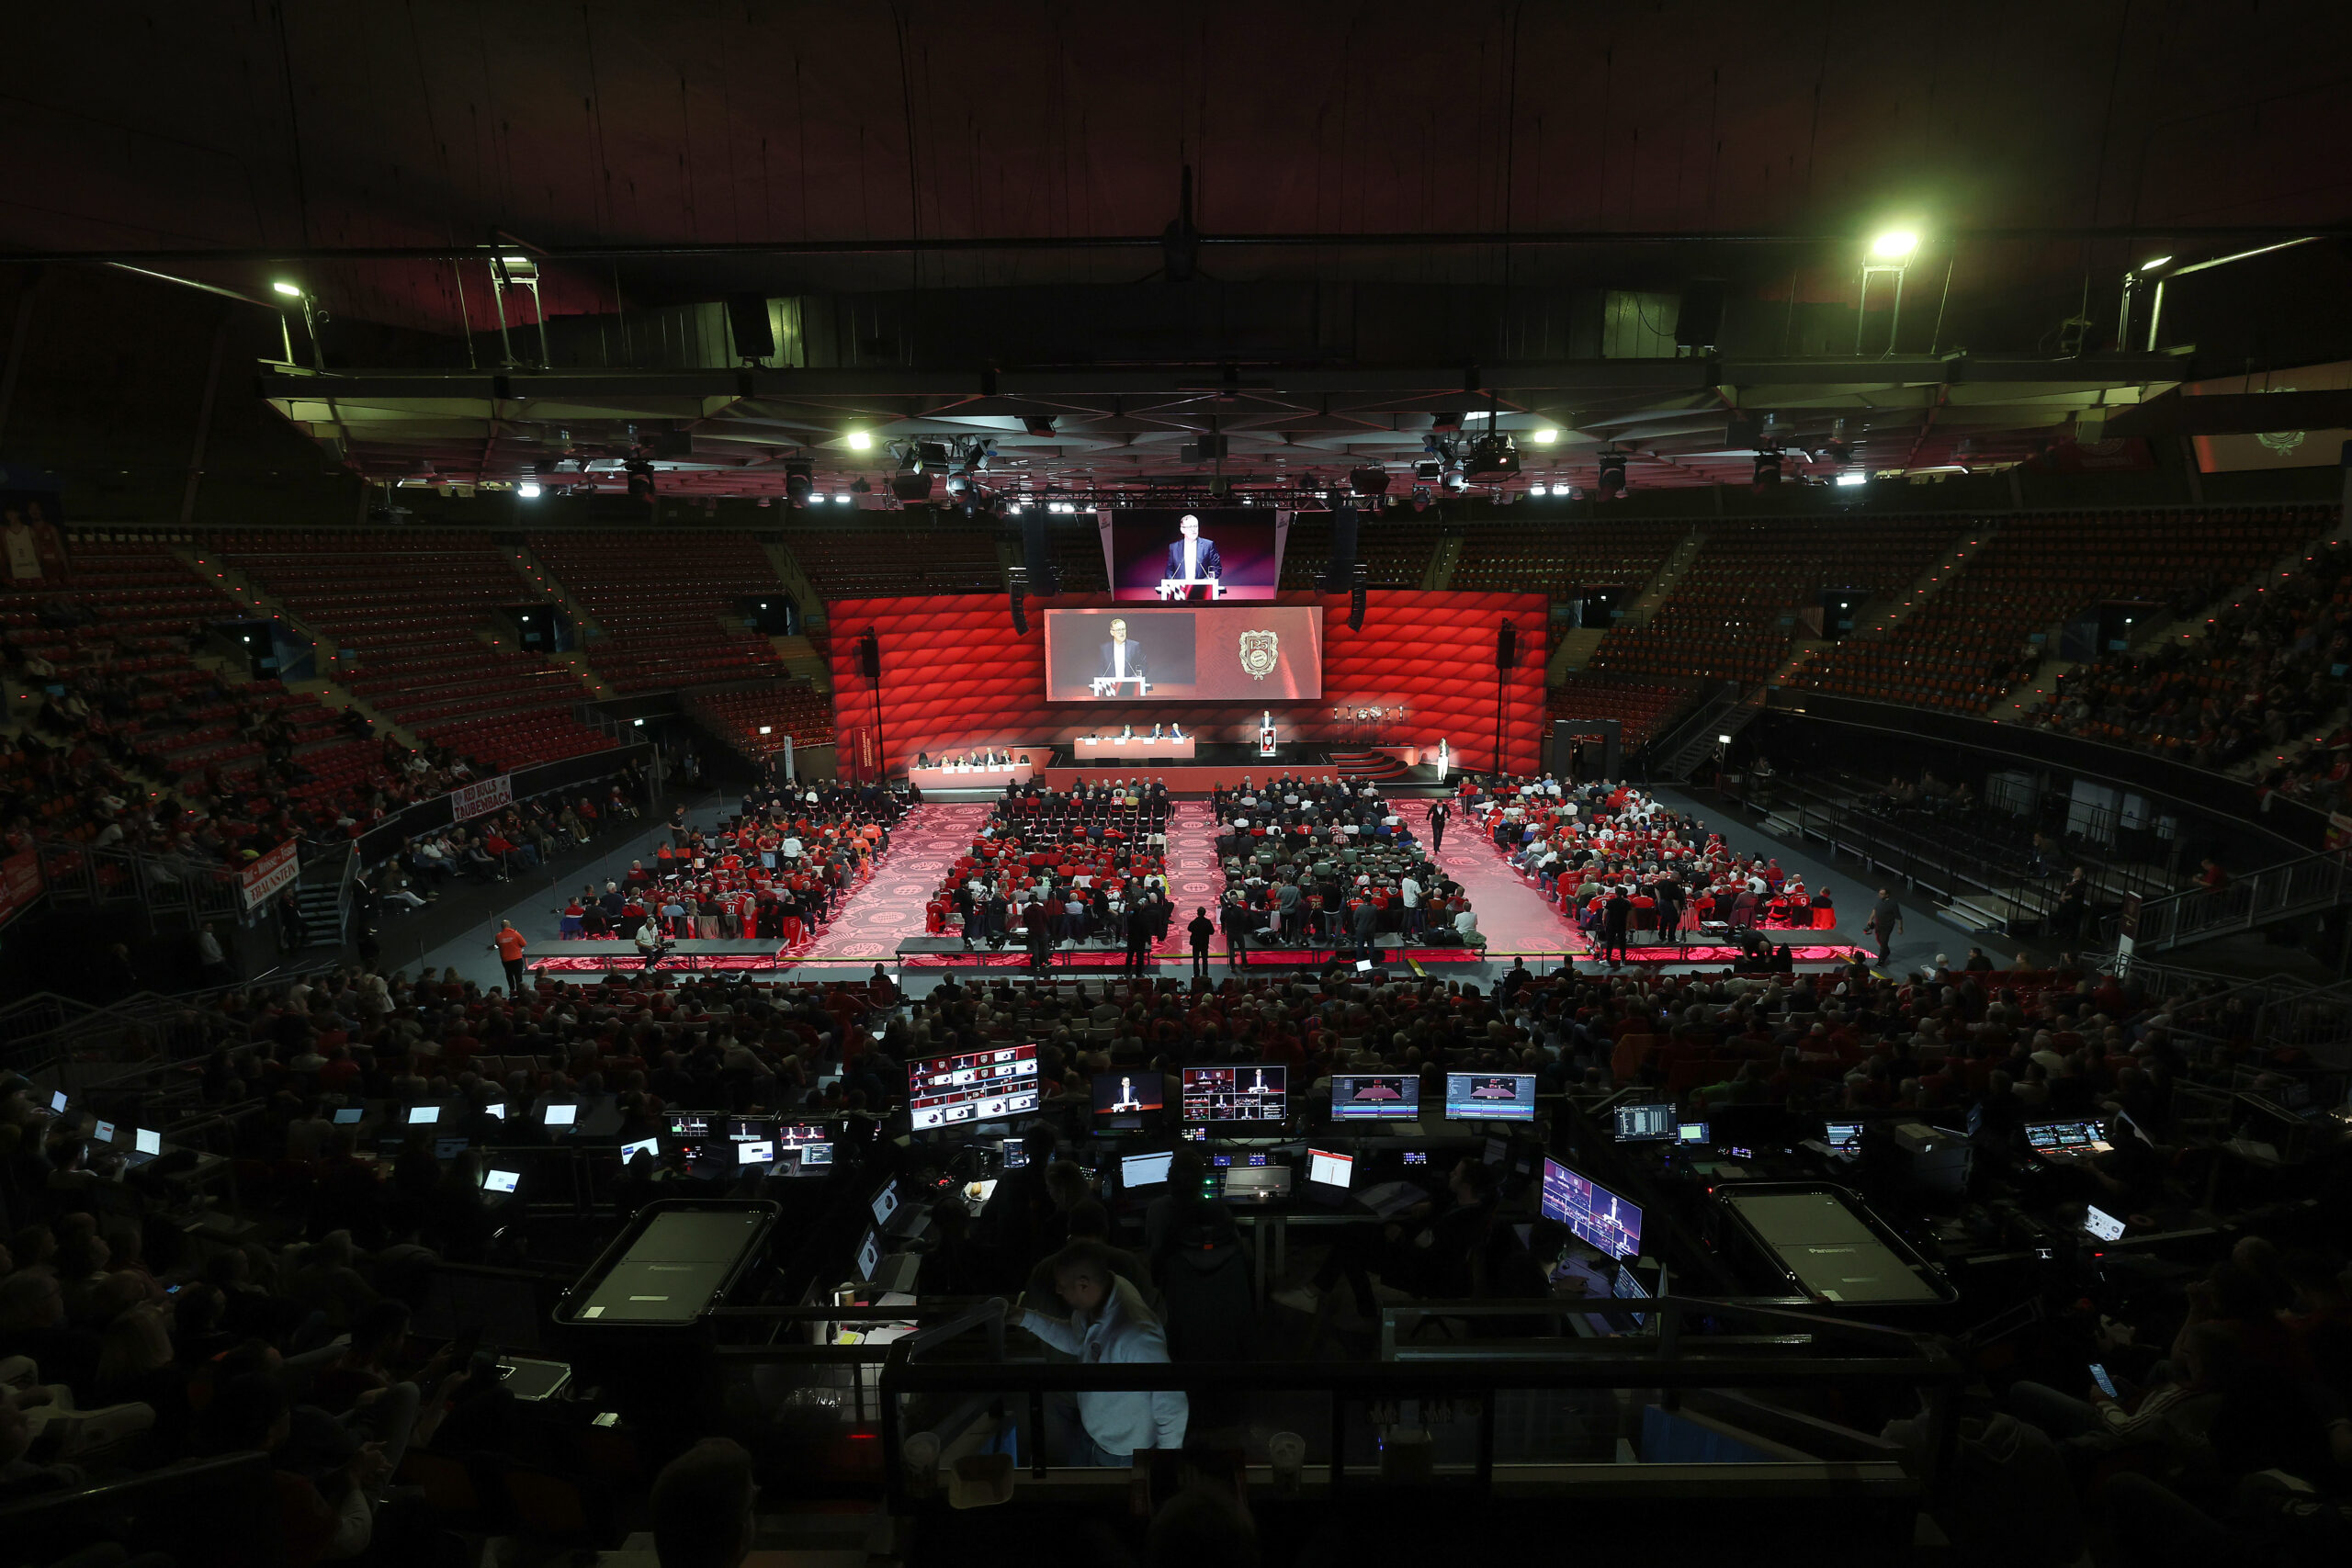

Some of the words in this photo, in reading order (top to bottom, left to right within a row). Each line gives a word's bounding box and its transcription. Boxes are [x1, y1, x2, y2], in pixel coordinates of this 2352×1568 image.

[1250, 639, 1268, 649] 125
[463, 786, 476, 802] RED
[476, 780, 497, 797] BULLS
[455, 791, 511, 819] TAUBENBACH
[727, 905, 735, 914] 31
